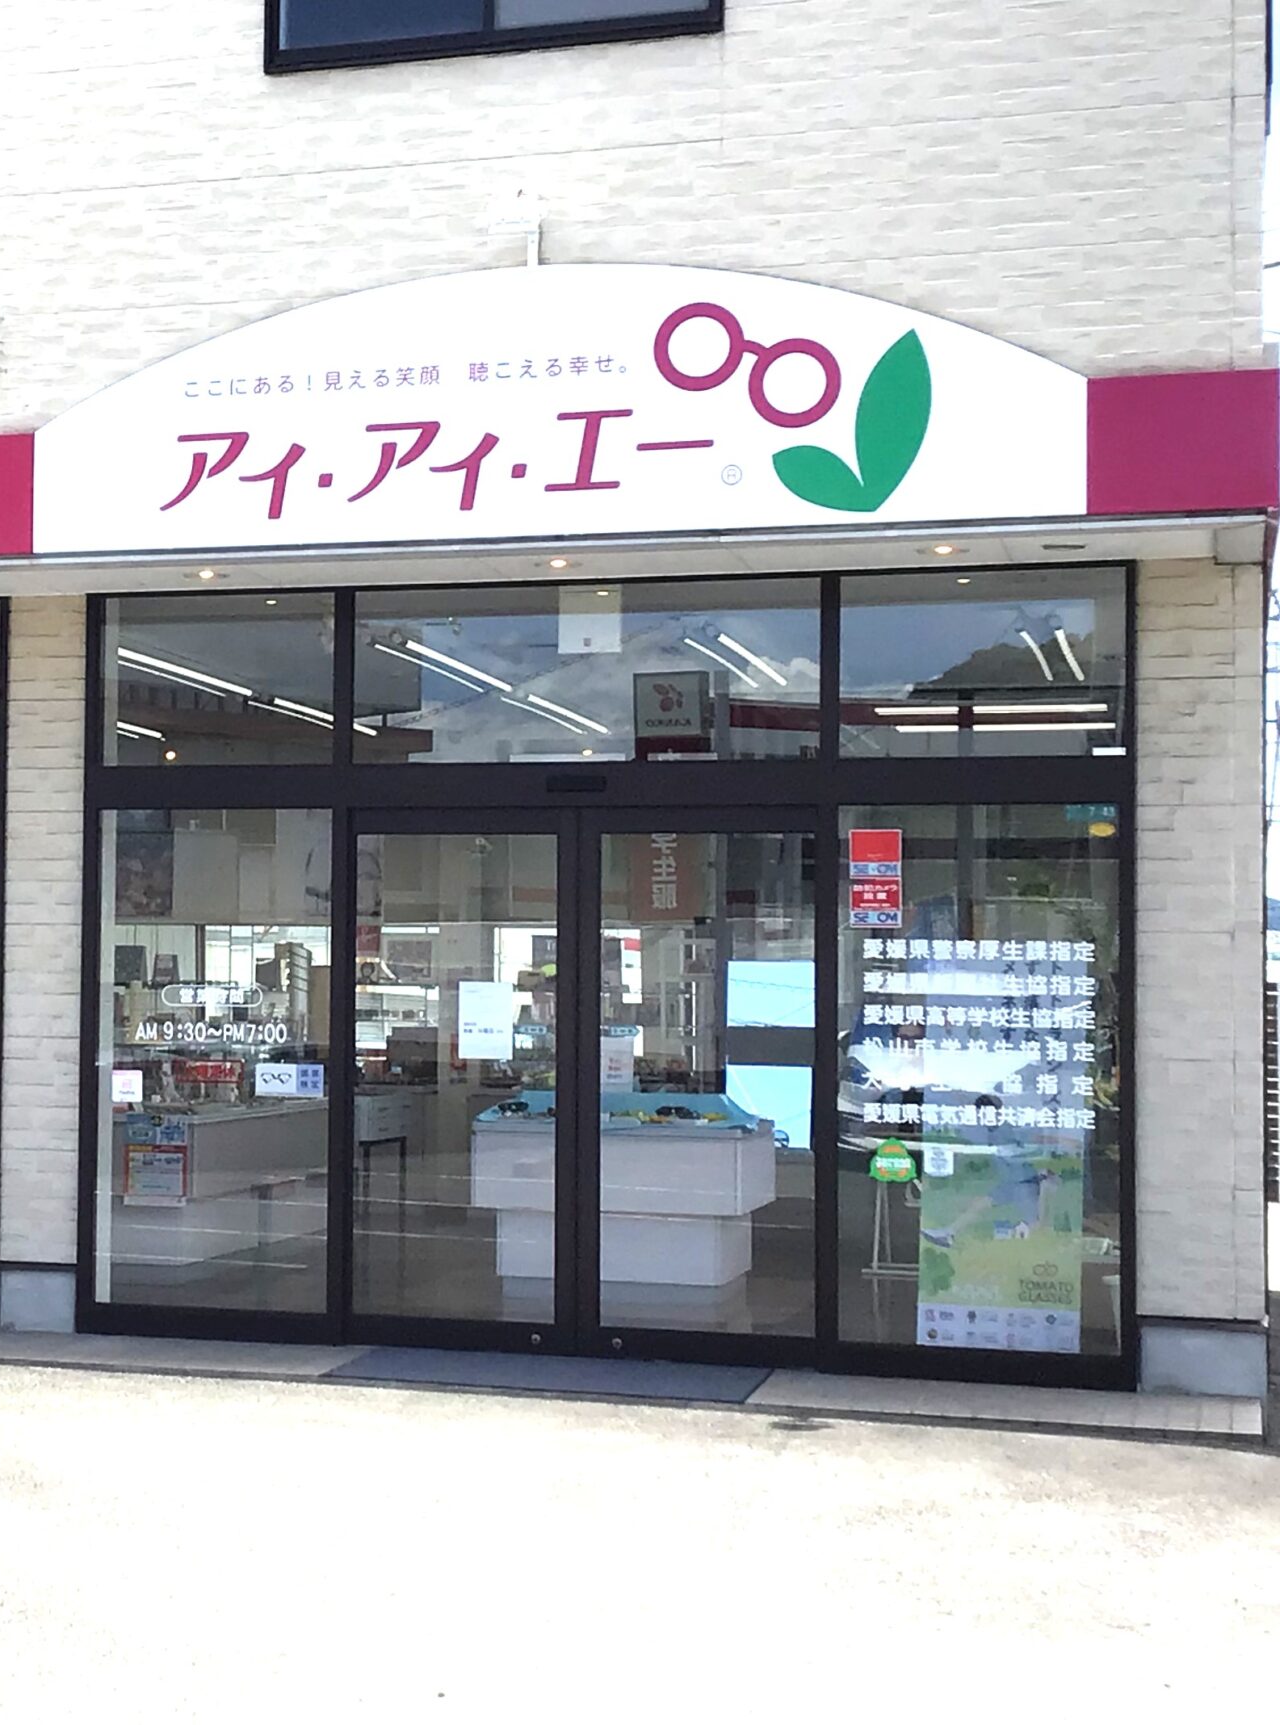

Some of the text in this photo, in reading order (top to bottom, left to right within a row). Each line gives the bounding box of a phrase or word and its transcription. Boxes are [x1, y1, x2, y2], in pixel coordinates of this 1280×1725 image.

[467, 354, 629, 383] 聴こえる幸せ。
[159, 408, 715, 520] アイ・アイ・エー
